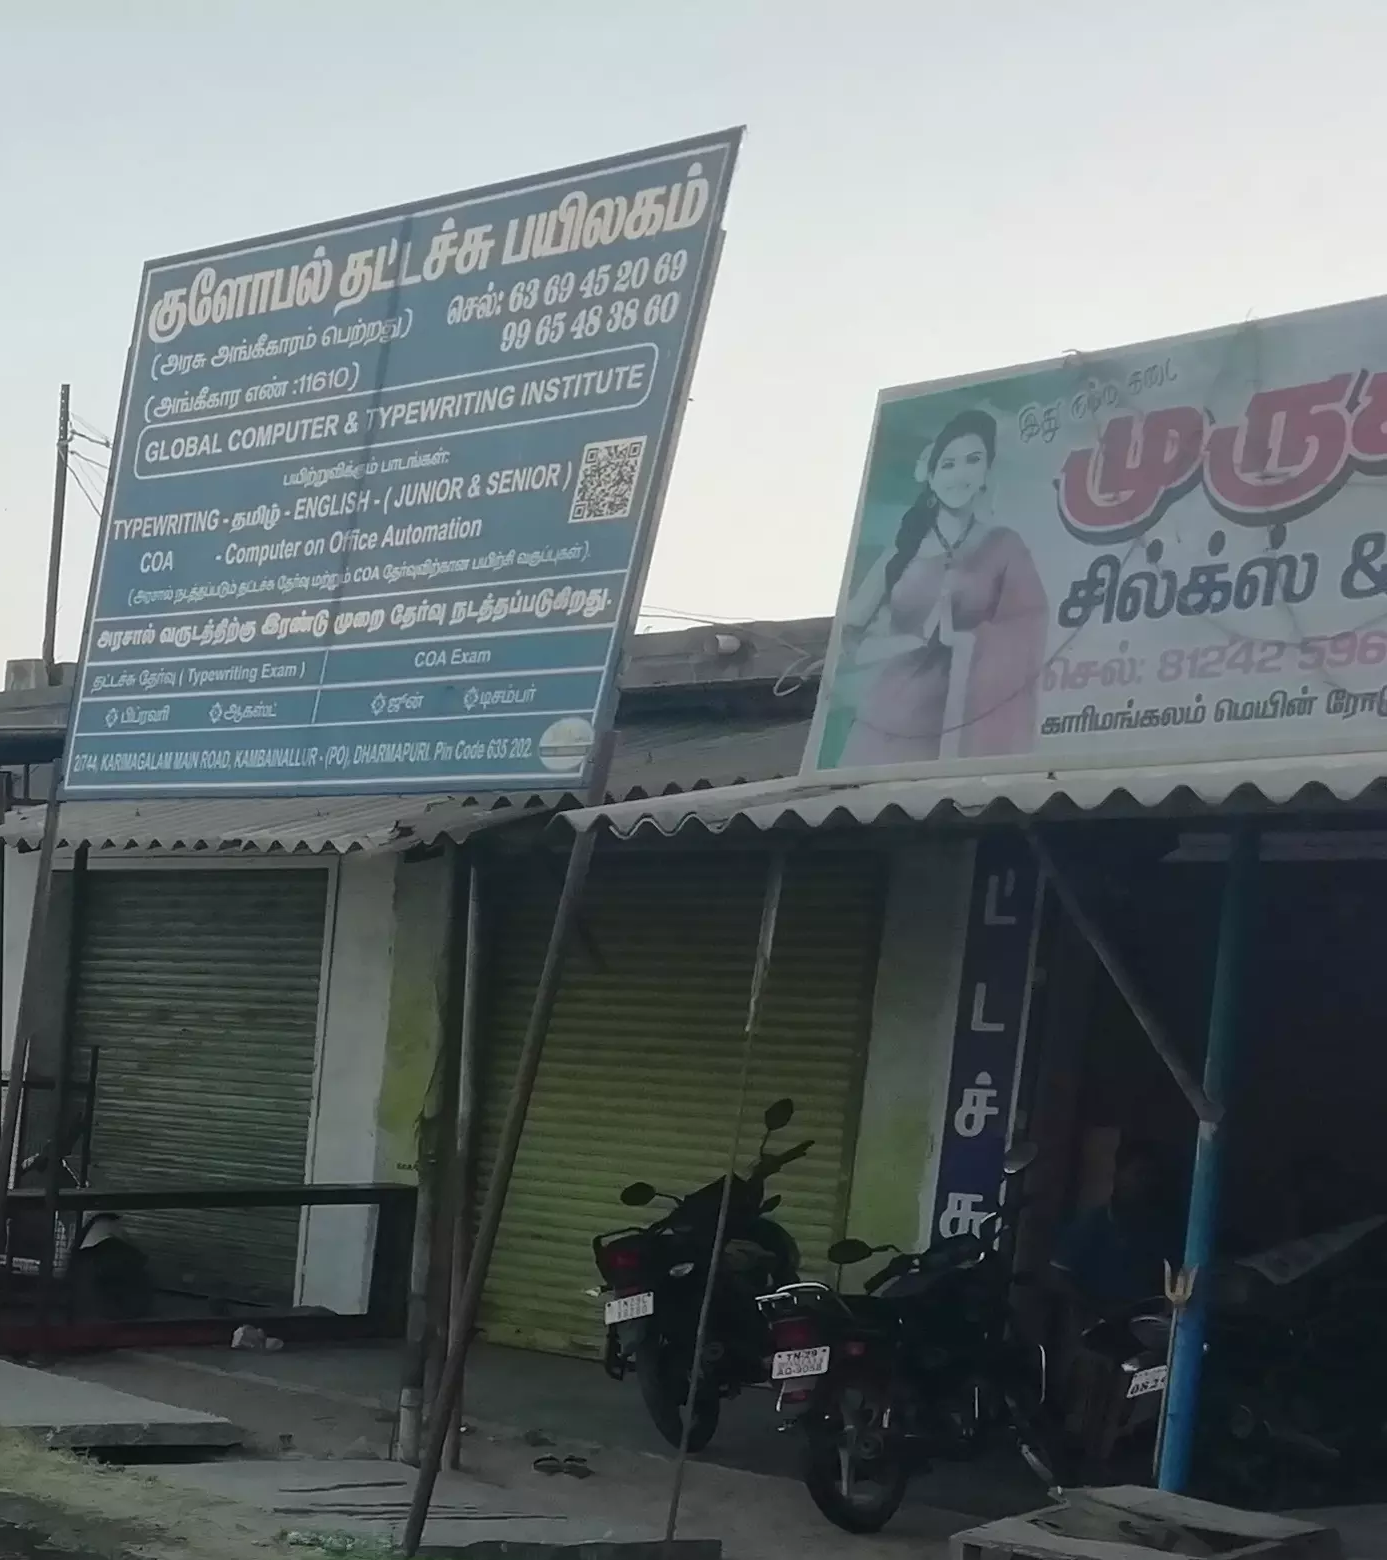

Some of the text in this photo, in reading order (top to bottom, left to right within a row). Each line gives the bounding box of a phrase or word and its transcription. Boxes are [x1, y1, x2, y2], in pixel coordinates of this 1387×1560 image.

[148, 161, 709, 344] குளோபல் தட்டச்சு பயிலகம்
[509, 277, 539, 313] 63
[543, 272, 575, 306] 69
[579, 264, 611, 298] 45
[613, 256, 649, 292] 20
[654, 249, 687, 285] 69
[500, 291, 680, 352] 99 65 48 38 60
[151, 353, 207, 381] (அரசு
[211, 326, 317, 367] அங்கீகாரம்
[144, 386, 241, 423] (அங்கீகார
[145, 364, 646, 464] GLOBAL COMPUTER & TYPEWRITING INSTITUTE
[114, 509, 220, 541] TYPEWRITING
[230, 503, 280, 533] தமிழ்
[294, 490, 371, 521] ENGLISH
[394, 475, 463, 508] JUNIOR
[467, 473, 481, 497] &
[486, 463, 561, 495] SENIOR
[140, 551, 174, 574] COA
[225, 539, 299, 567] Computer
[304, 538, 324, 556] on
[329, 527, 378, 552] Office
[381, 516, 482, 548] Automation
[353, 565, 379, 583] COA
[1057, 524, 1387, 628] சில்க்ஸ் &
[261, 609, 329, 641] இரண்டு
[334, 608, 385, 634] முறை
[390, 599, 446, 630] தேர்வு
[187, 663, 258, 687] Typewriting
[261, 663, 297, 679] Exam
[414, 648, 491, 669] COA Exam
[1042, 640, 1146, 693] செல்:
[1157, 635, 1286, 684] 81242
[1040, 693, 1206, 736] காரிமங்கலம்
[1213, 685, 1319, 724] மெயின்
[434, 738, 452, 761] Pin
[455, 738, 484, 761] Code
[487, 737, 508, 759] 635
